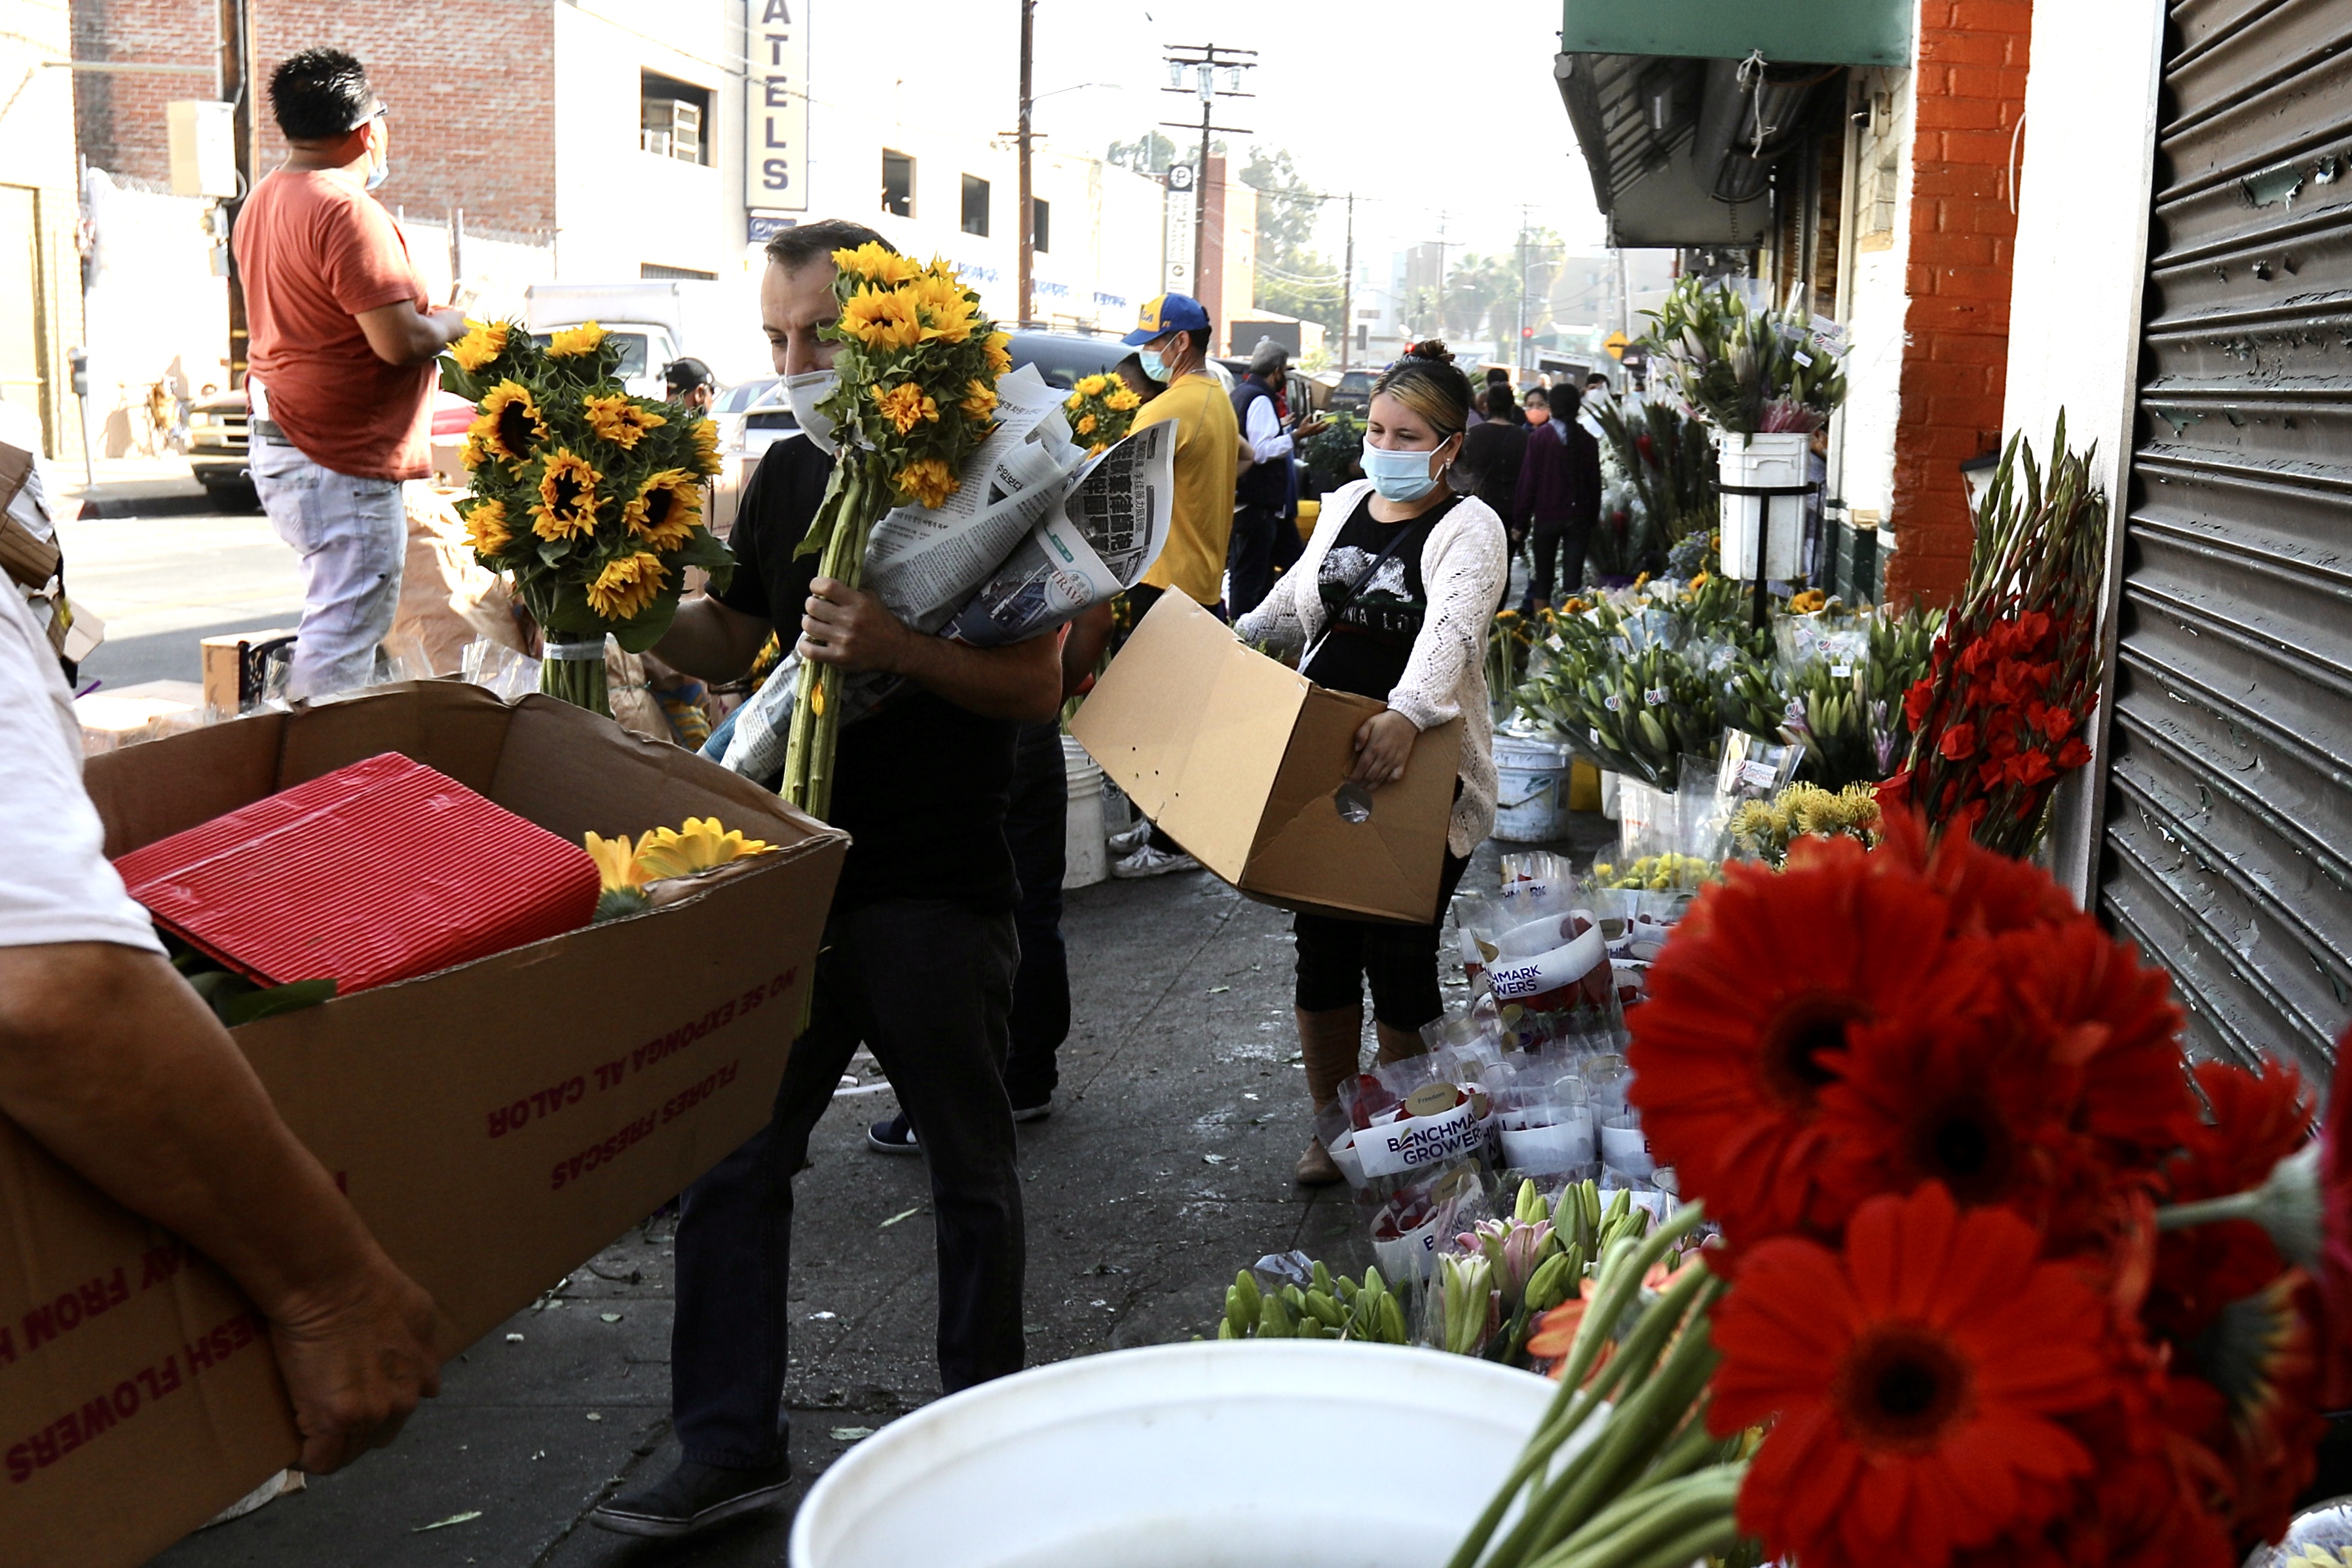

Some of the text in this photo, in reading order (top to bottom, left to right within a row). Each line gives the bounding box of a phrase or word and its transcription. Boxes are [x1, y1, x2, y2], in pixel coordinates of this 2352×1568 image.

[996, 463, 1025, 493] 수입보다
[487, 965, 798, 1140] NO SE EXPONGA AL CALOR
[551, 1058, 738, 1190] FLORES FRESCAS
[1418, 1092, 1446, 1104] Freedom
[1387, 1112, 1478, 1153] BENCHMA
[1403, 1127, 1482, 1165] GROWER
[23, 1266, 130, 1351] FROM
[5, 1354, 183, 1484] FLOWERS
